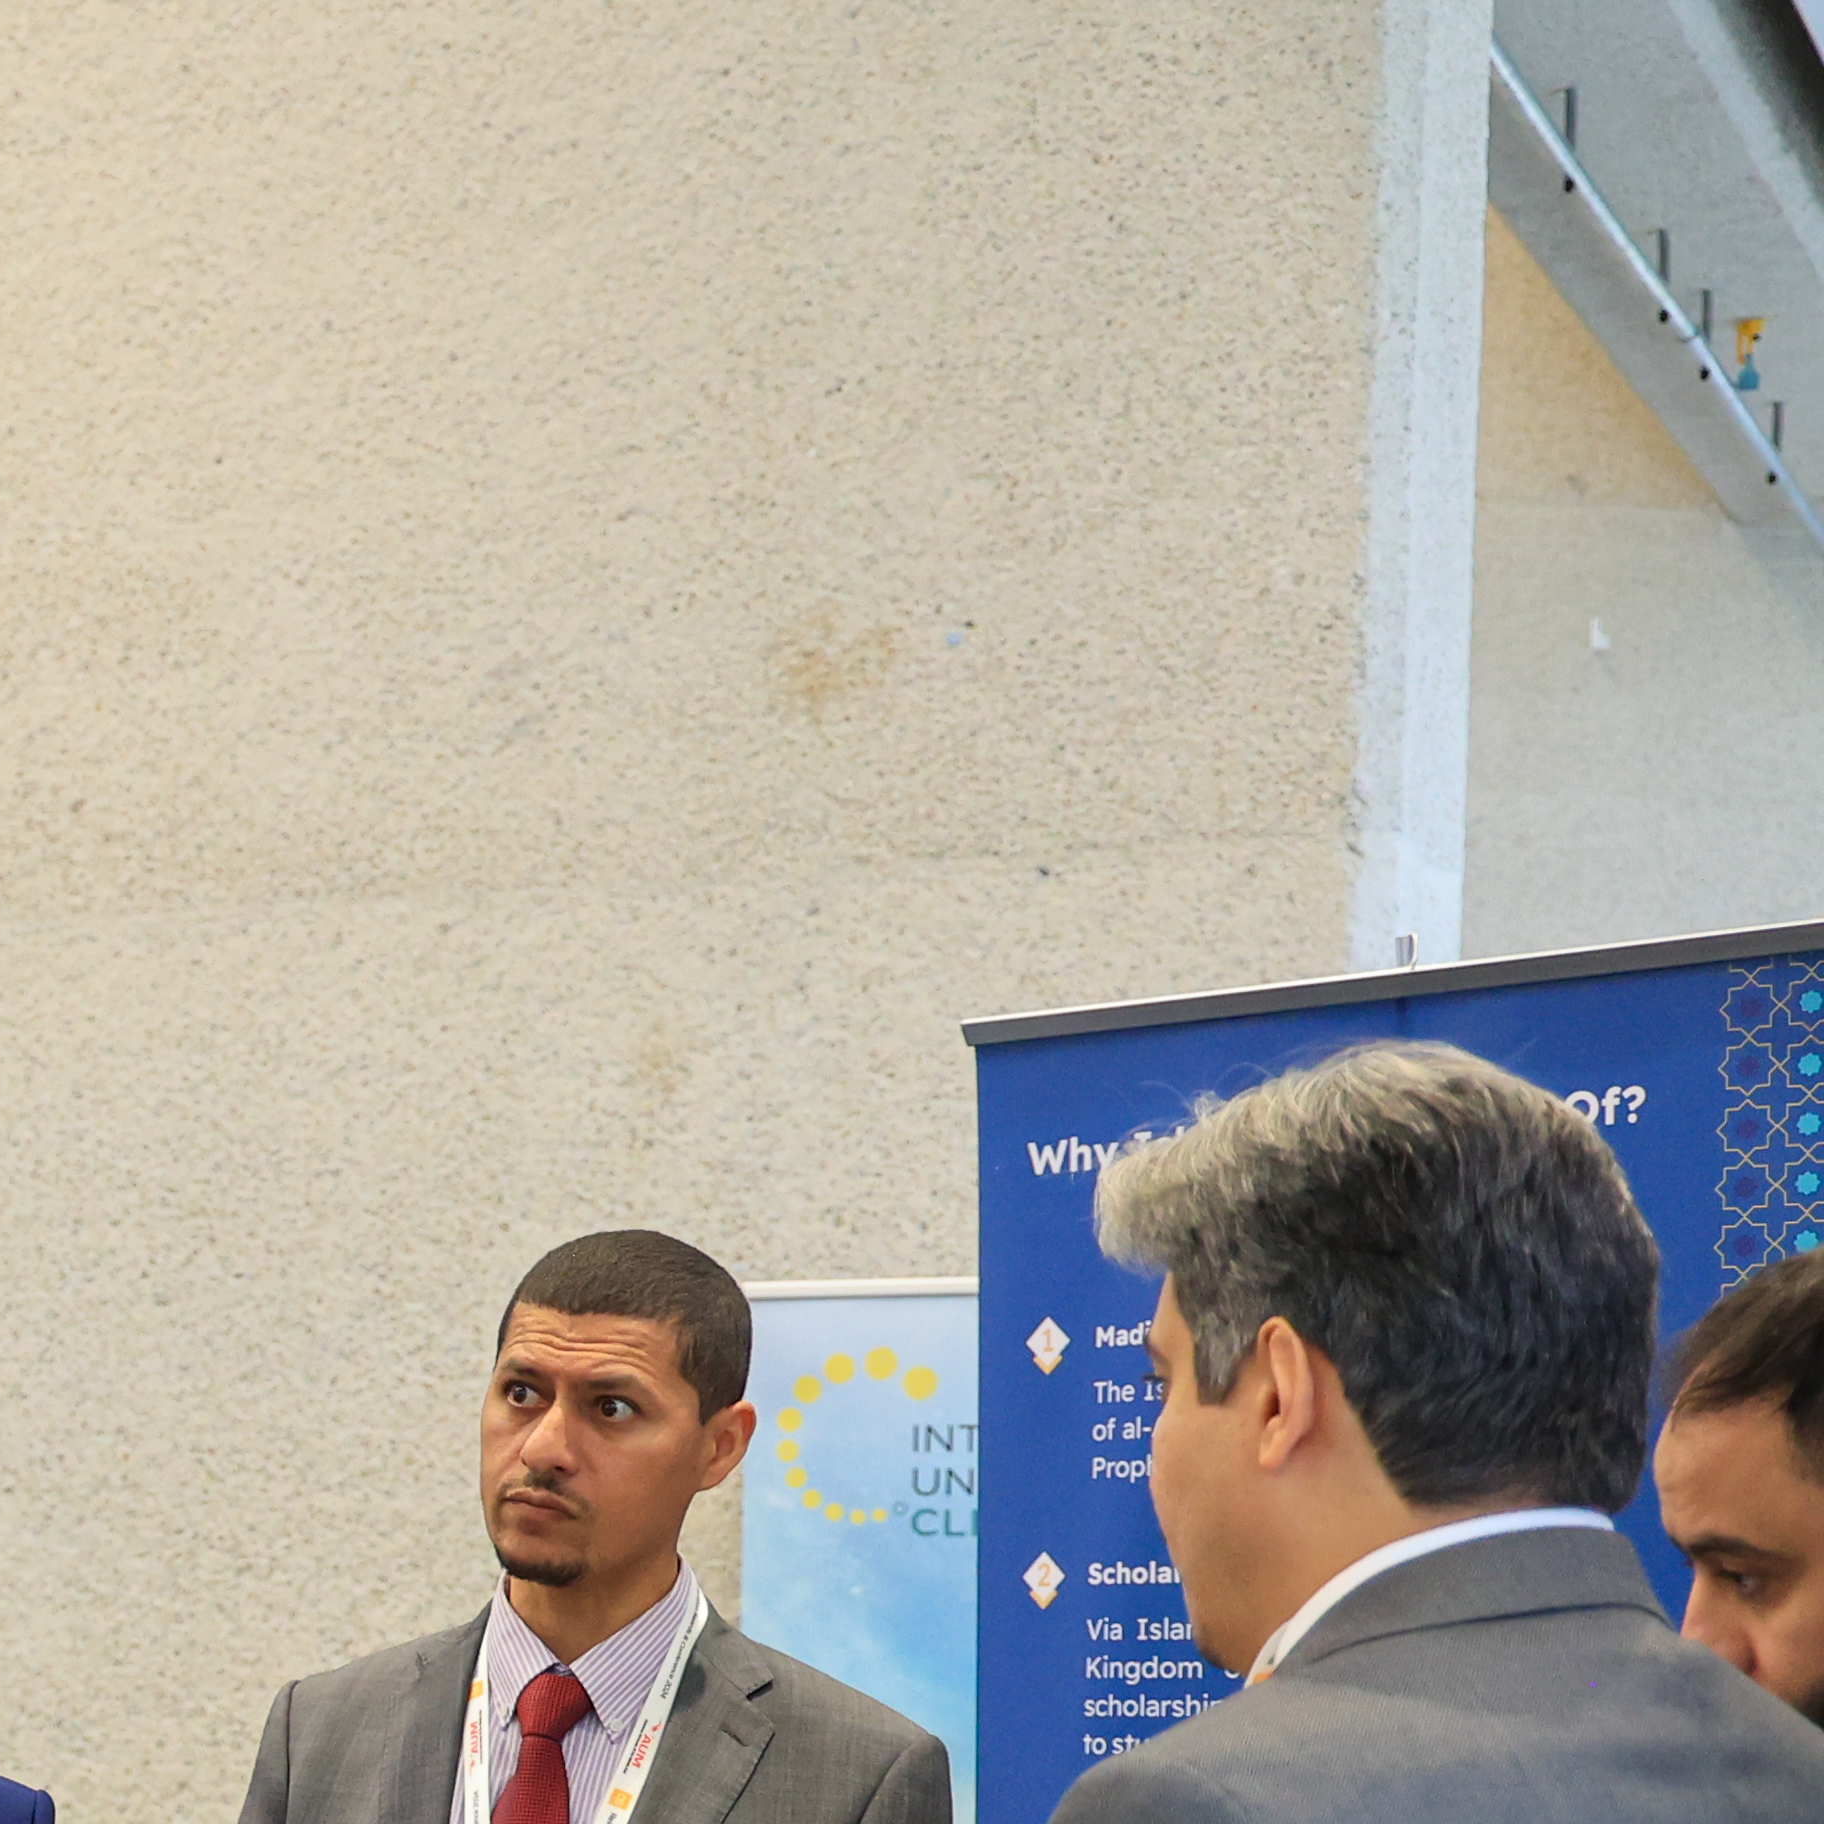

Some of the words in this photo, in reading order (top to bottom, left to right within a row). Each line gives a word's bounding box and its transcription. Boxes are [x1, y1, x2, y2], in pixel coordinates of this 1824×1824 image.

[1042, 1329, 1055, 1353] 1
[1093, 1379, 1136, 1404] The
[1091, 1417, 1116, 1442] of
[1122, 1416, 1153, 1441] al-
[912, 1467, 976, 1496] UN
[1037, 1562, 1051, 1588] 2
[1086, 1617, 1123, 1642] Via
[668, 1640, 686, 1679] Conference
[1085, 1655, 1203, 1686] Kingdom
[660, 1679, 672, 1698] 2024
[470, 1721, 479, 1754] AUM
[1082, 1733, 1107, 1756] to
[1112, 1733, 1147, 1755] st
[631, 1733, 653, 1769] AUM
